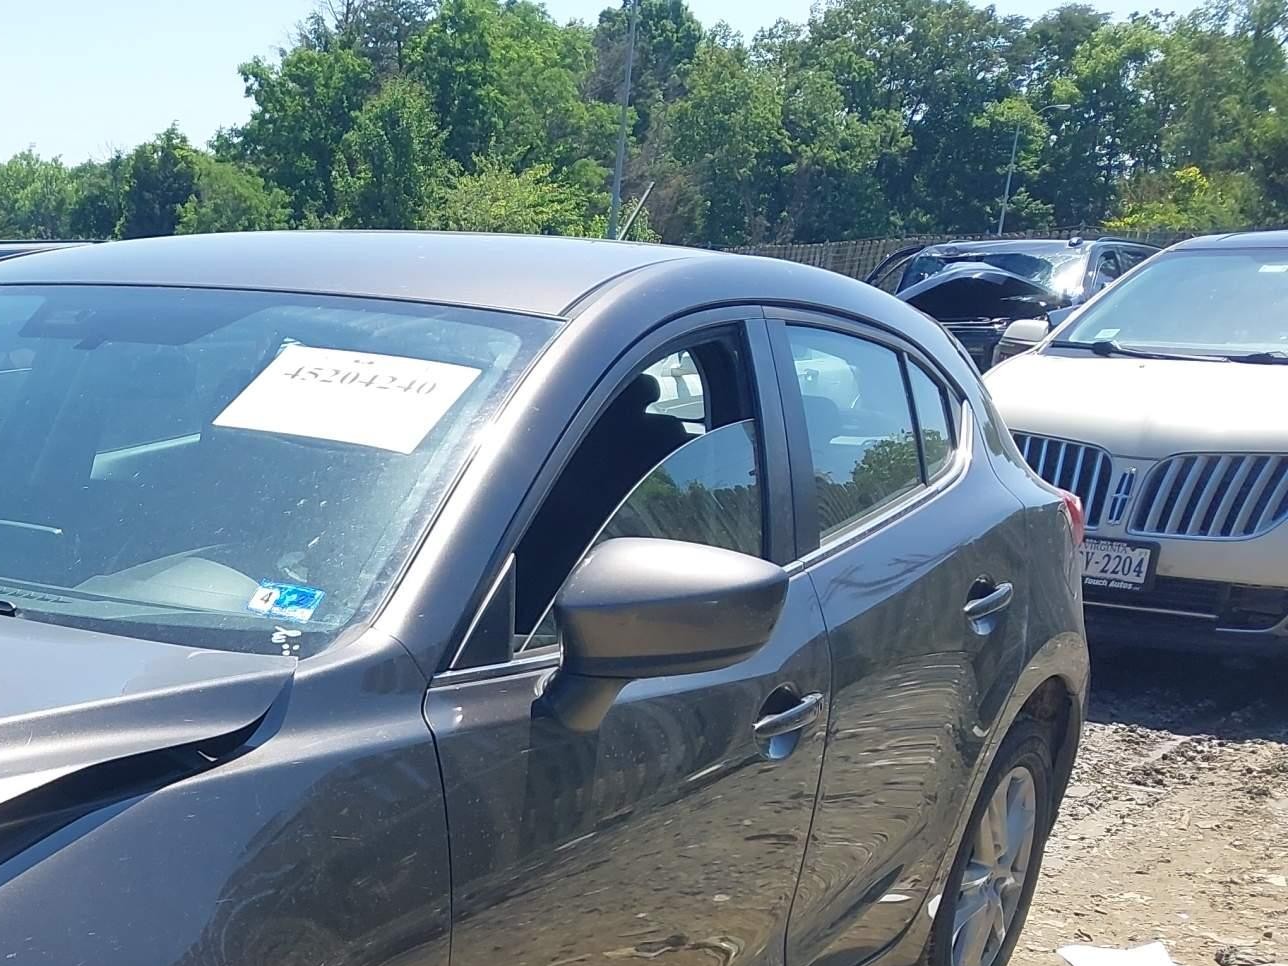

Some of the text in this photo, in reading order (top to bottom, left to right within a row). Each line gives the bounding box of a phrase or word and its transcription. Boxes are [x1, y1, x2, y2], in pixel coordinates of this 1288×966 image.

[283, 365, 437, 396] 45204240
[1079, 550, 1144, 577] V-2204
[261, 592, 273, 604] 4
